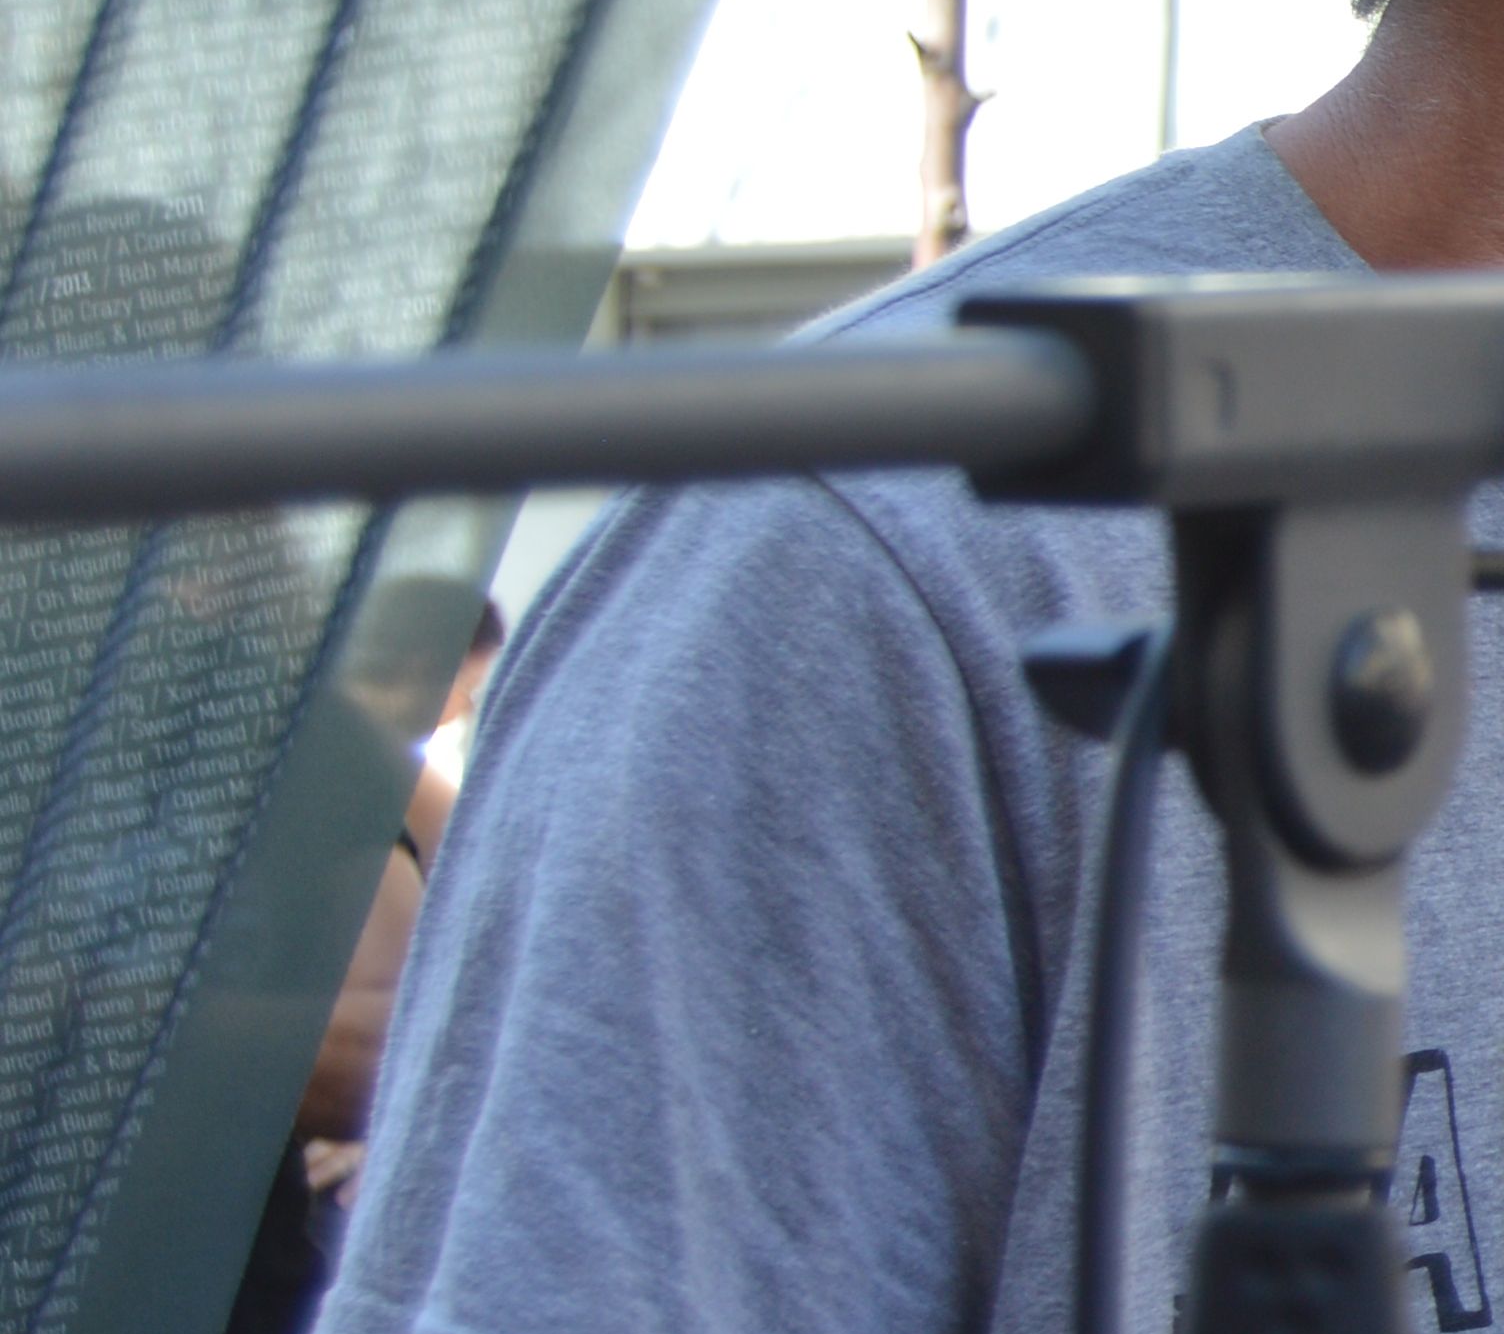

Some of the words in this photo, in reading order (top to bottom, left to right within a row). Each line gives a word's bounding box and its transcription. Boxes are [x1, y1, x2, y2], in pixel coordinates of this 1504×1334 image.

[164, 194, 204, 221] 2011
[52, 270, 92, 299] 2013
[34, 310, 46, 331] &
[80, 297, 133, 322] Crazy
[139, 286, 193, 311] Blues
[55, 331, 106, 355] Blues
[113, 321, 127, 344] &
[8, 538, 61, 562] Laura
[68, 525, 128, 550] Pastor
[222, 532, 247, 554] La
[36, 590, 65, 612] Oh
[172, 597, 184, 618] A
[171, 617, 224, 648] Coral
[174, 647, 218, 676] Soul
[241, 635, 279, 656] The
[166, 676, 209, 705] Xavi
[214, 667, 267, 691] Rizzo
[130, 709, 193, 740] Sweet
[199, 694, 260, 721] Marta
[265, 687, 278, 710] &
[152, 740, 189, 763] The
[195, 721, 248, 749] Road
[173, 786, 225, 809] Open
[58, 864, 134, 894] Howling
[50, 901, 95, 923] Miau
[48, 924, 109, 952] Daddy
[117, 913, 130, 933] &
[139, 906, 174, 926] The
[7, 989, 54, 1016] Band
[4, 1018, 54, 1044] Band
[81, 1023, 138, 1048] Steve
[85, 1054, 100, 1074] &
[57, 1081, 101, 1108] Soul
[61, 1112, 112, 1133] Blues
[30, 1139, 77, 1166] Vidal
